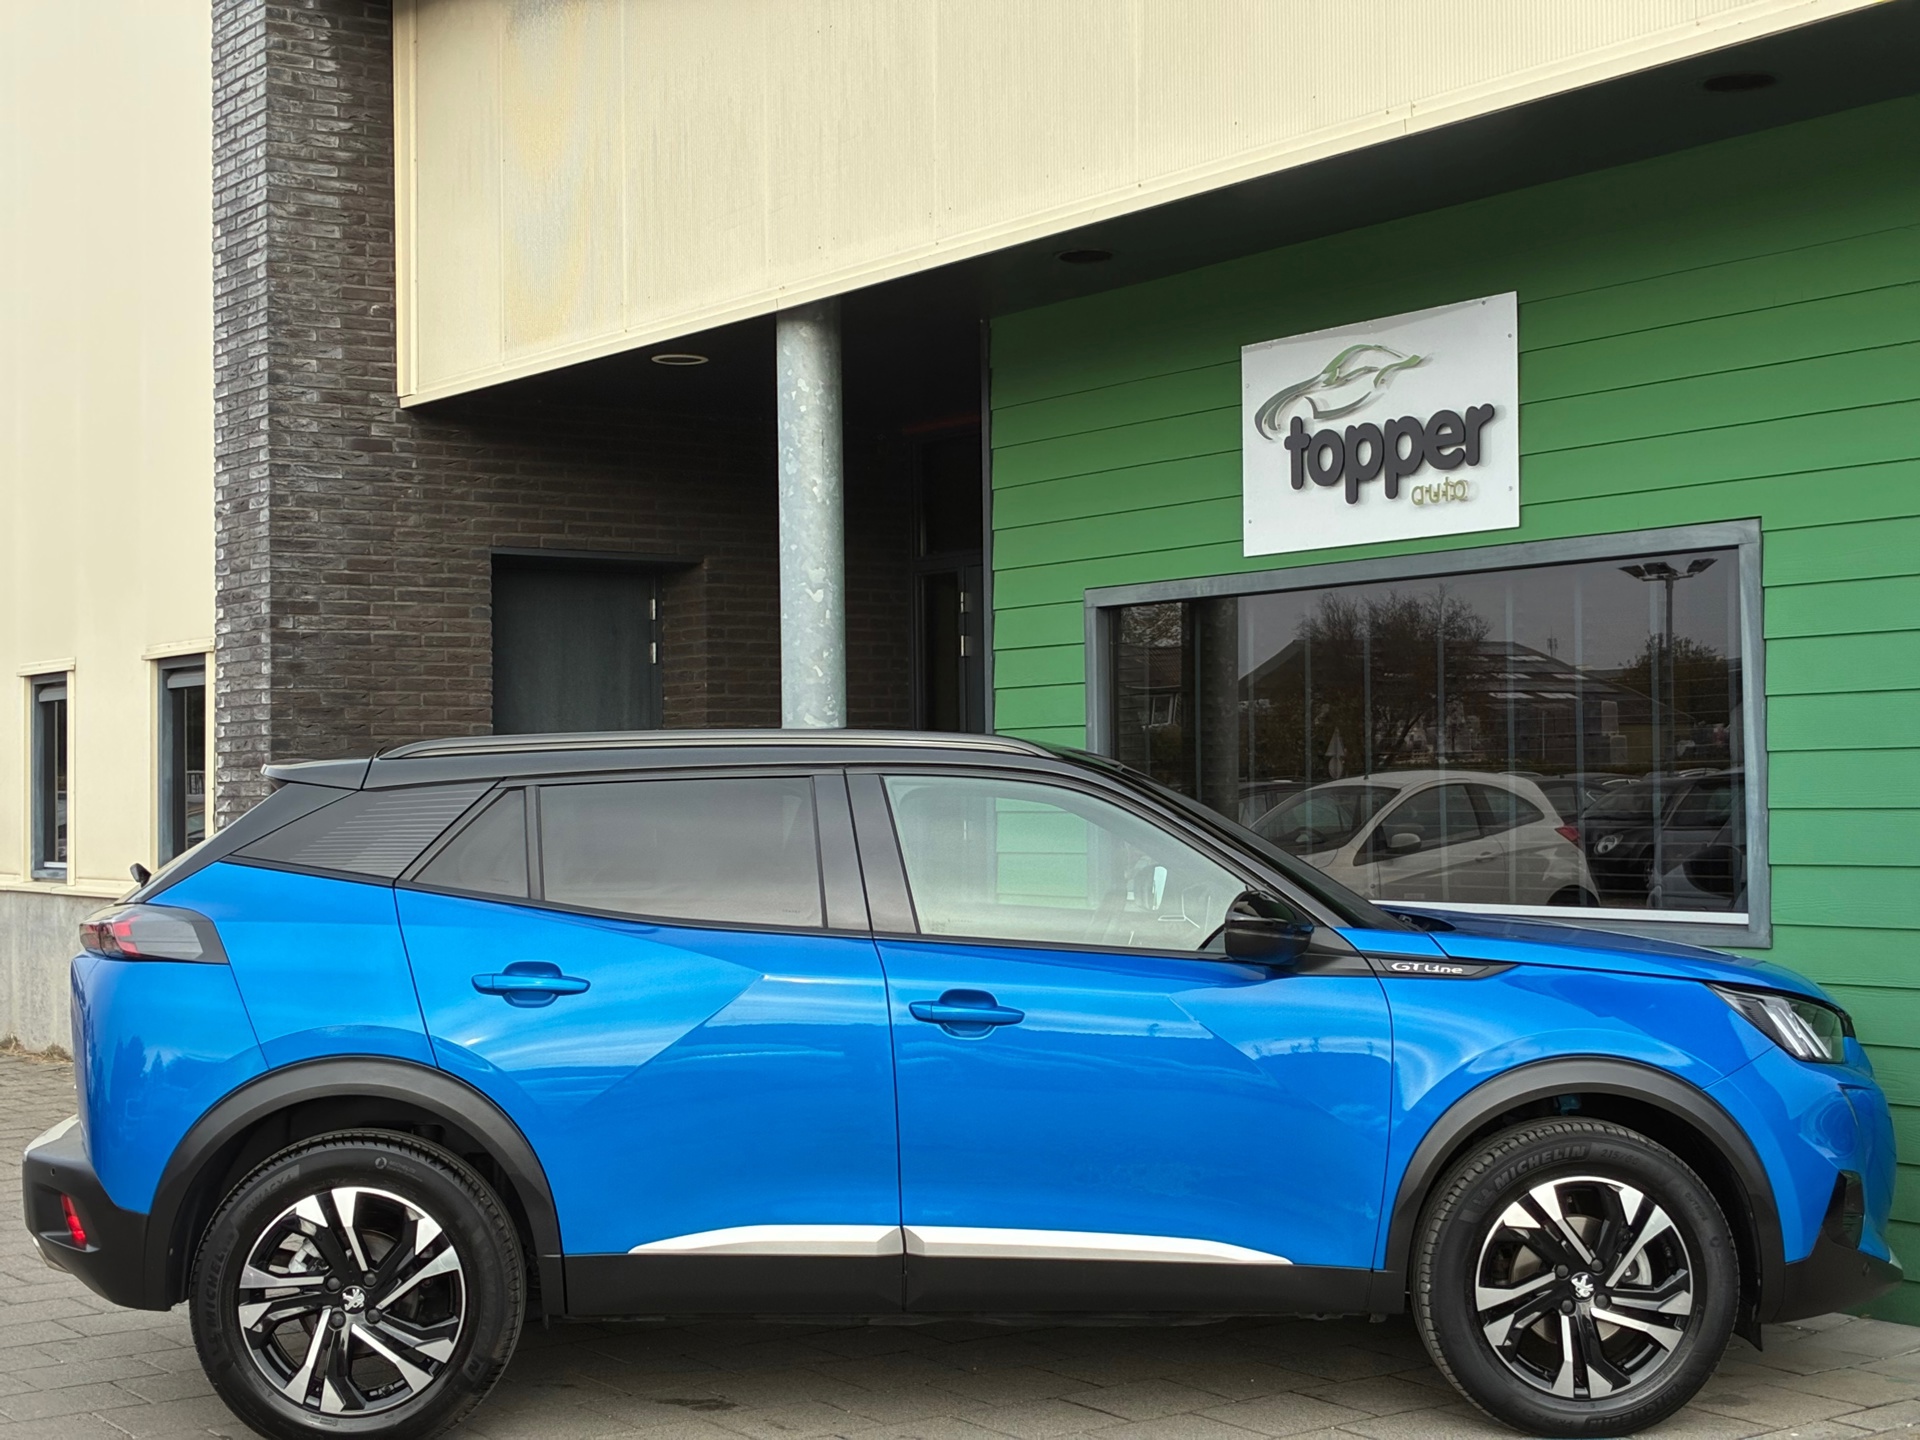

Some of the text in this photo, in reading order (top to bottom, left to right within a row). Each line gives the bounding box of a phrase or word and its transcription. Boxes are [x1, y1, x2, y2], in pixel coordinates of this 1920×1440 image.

[1283, 402, 1496, 505] topper
[1411, 476, 1469, 506] auto
[1390, 961, 1425, 972] GT
[1493, 1145, 1587, 1190] MICHELIN
